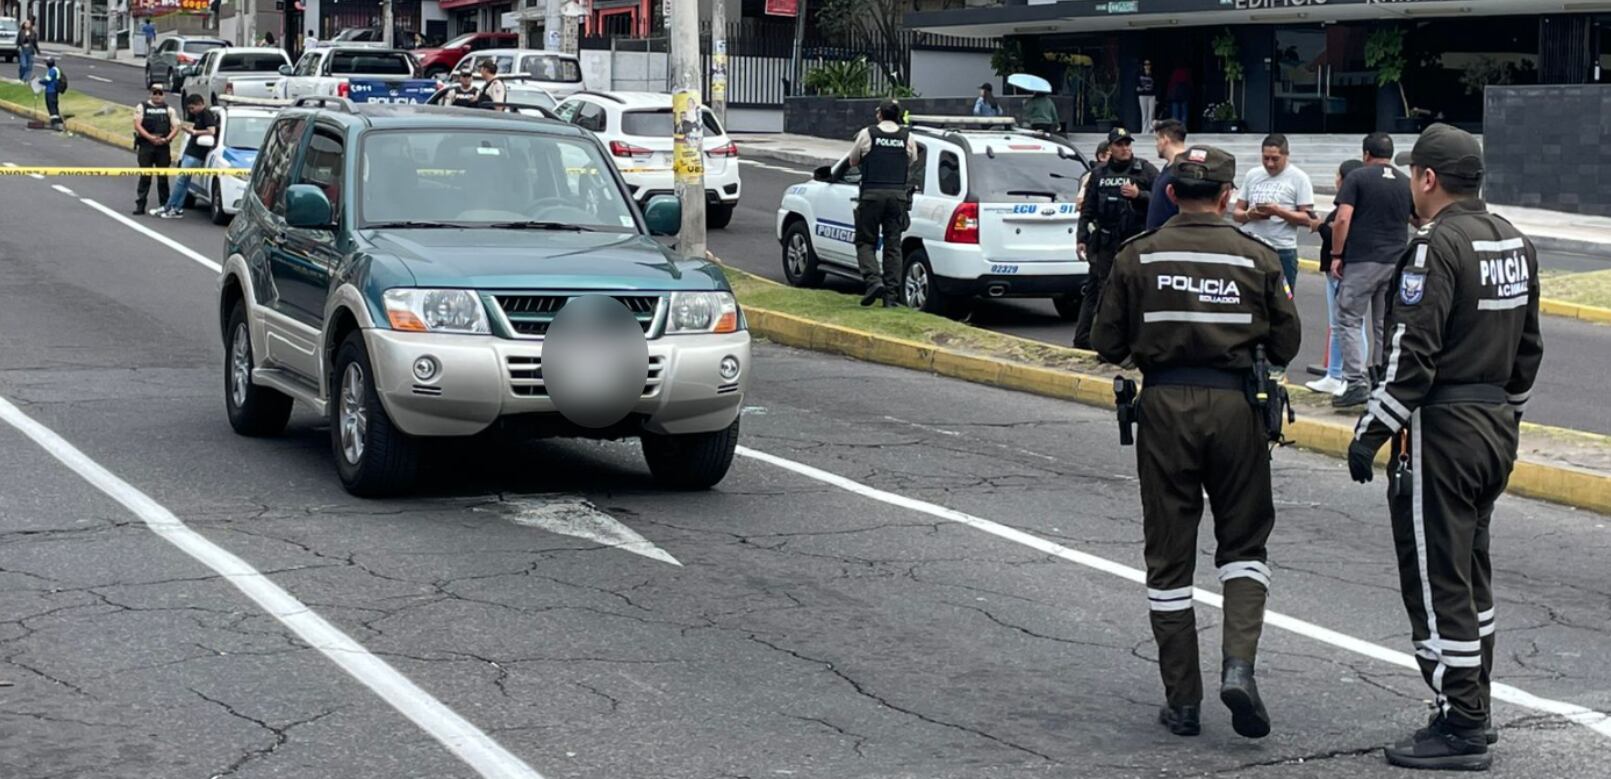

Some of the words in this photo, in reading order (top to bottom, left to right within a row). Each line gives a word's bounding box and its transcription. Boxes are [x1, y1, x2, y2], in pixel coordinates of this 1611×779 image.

[875, 137, 905, 148] POLICIA
[1013, 204, 1038, 214] ECU
[1199, 294, 1240, 305] ECUADOR
